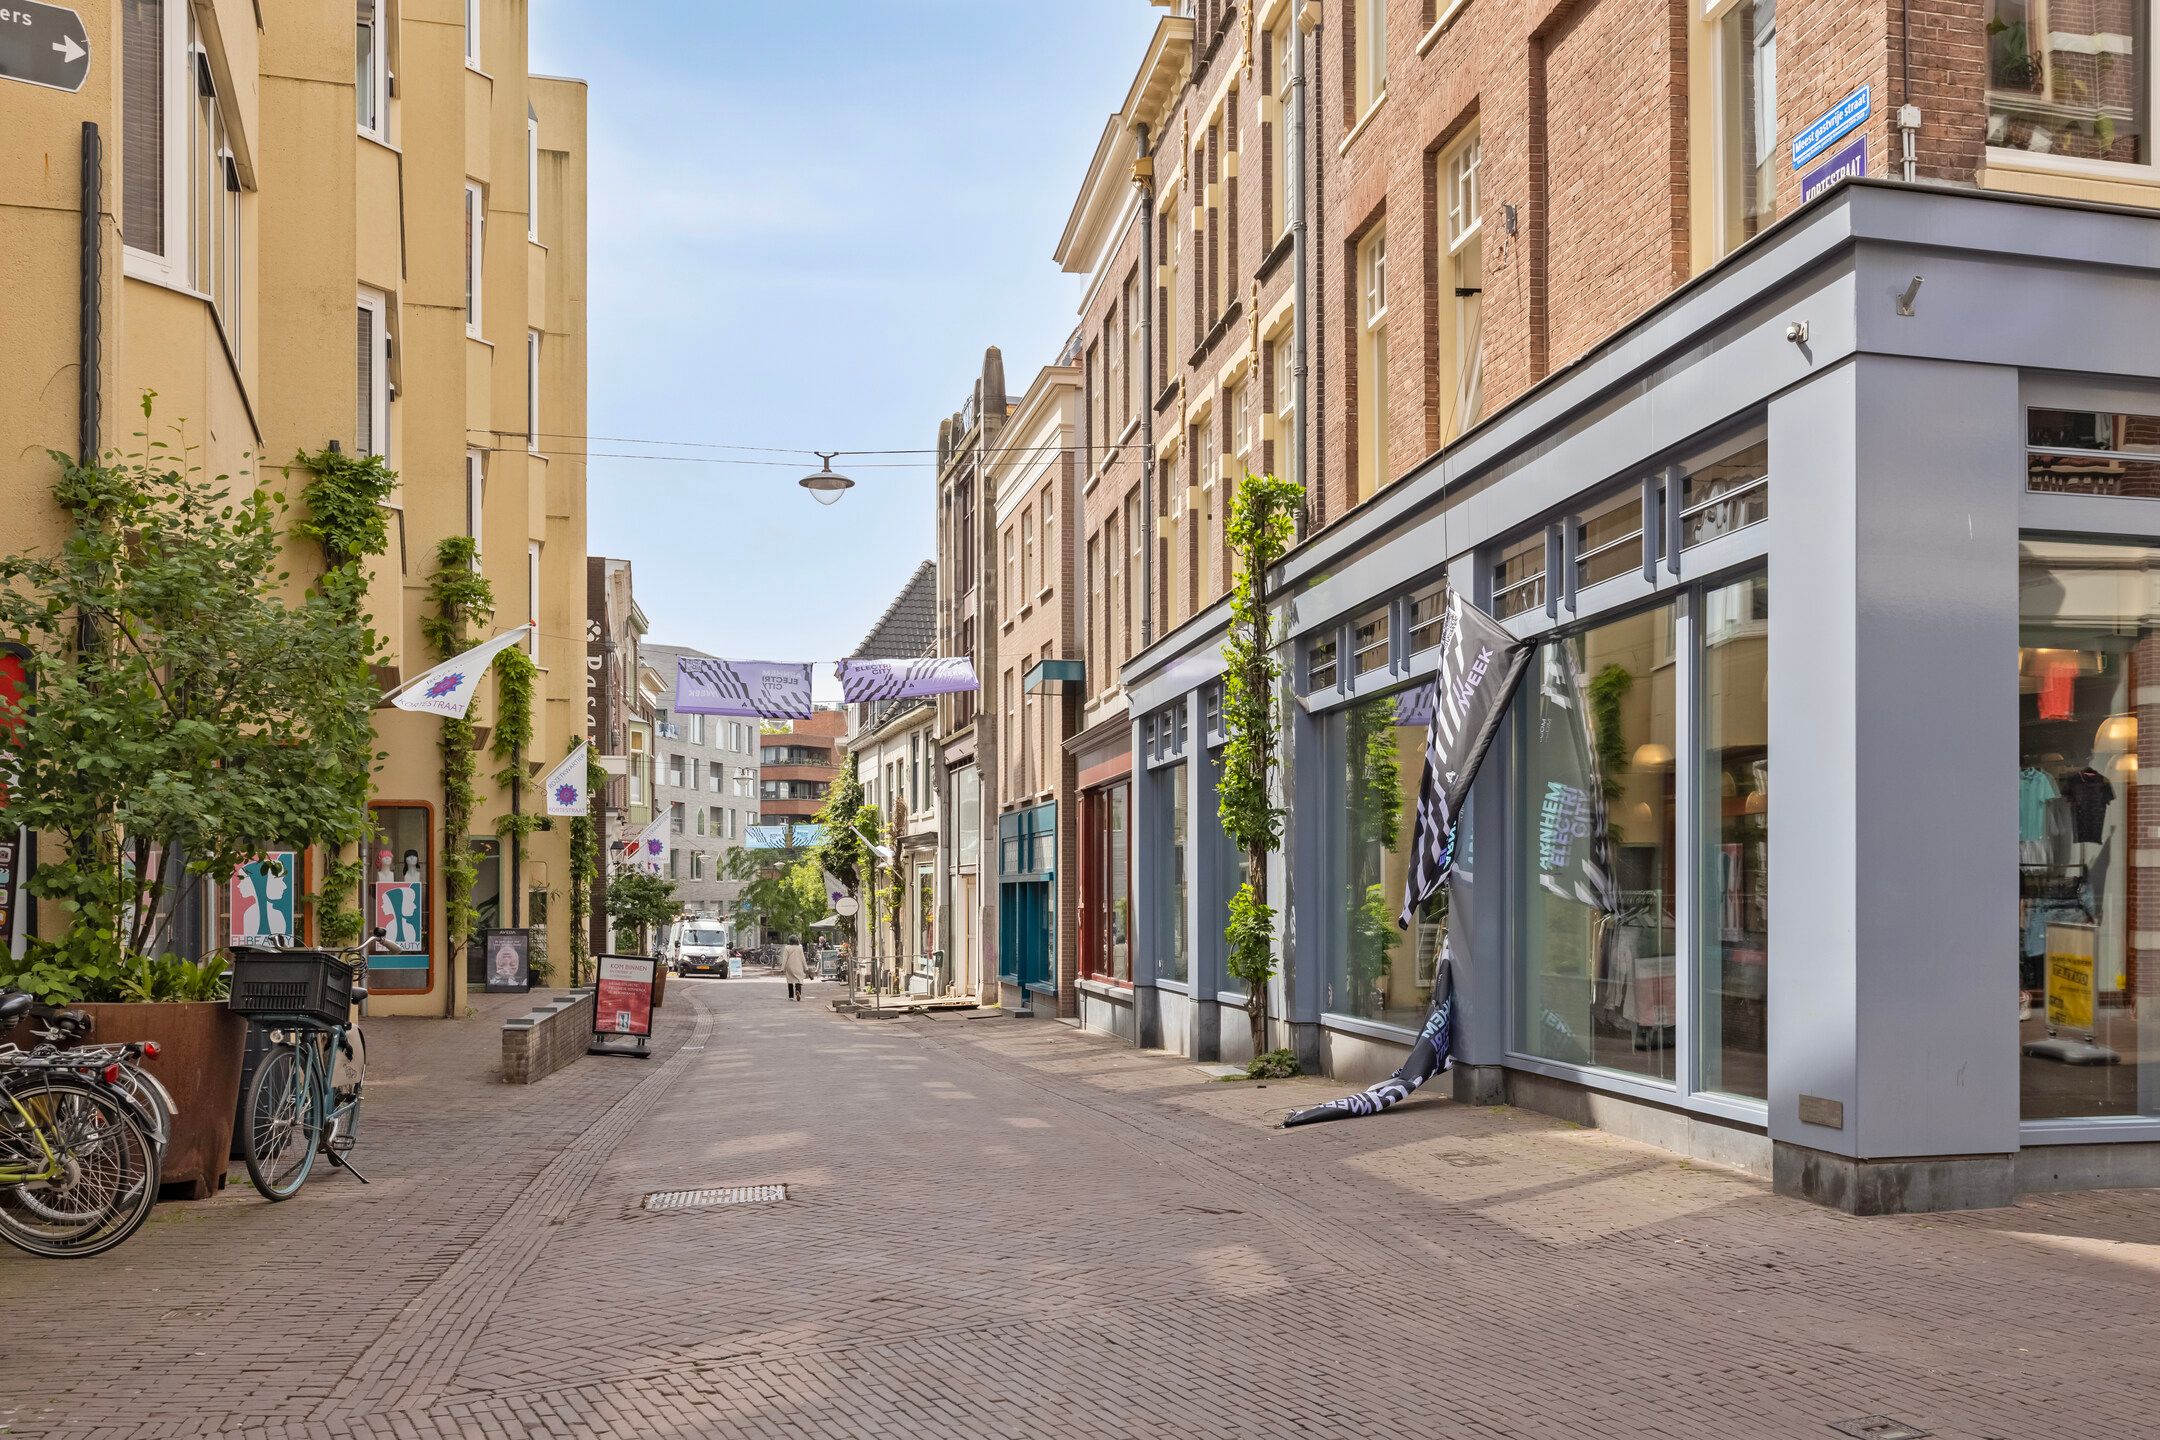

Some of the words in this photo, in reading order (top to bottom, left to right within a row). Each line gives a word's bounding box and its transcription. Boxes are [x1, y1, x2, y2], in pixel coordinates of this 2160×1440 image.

[0, 8, 32, 26] ers
[1795, 133, 1815, 153] Meest
[1815, 110, 1844, 142] gastvrije
[1843, 94, 1866, 117] straat
[1453, 645, 1494, 717] WEEK
[548, 753, 586, 789] ROZETKWARTIER
[1539, 781, 1567, 870] ARNHEM
